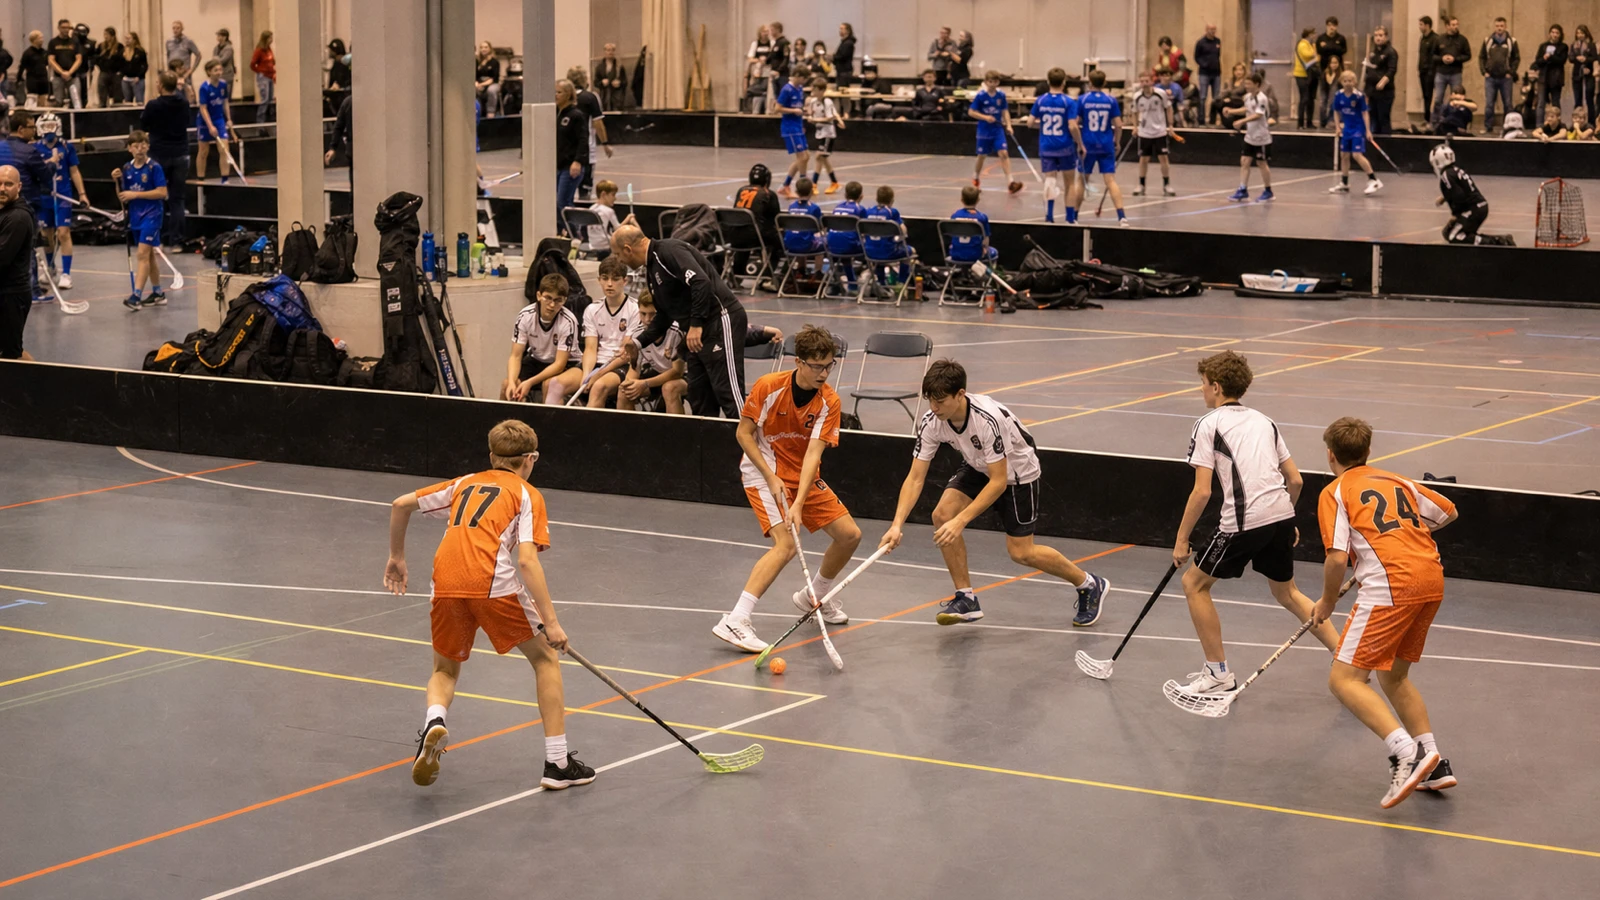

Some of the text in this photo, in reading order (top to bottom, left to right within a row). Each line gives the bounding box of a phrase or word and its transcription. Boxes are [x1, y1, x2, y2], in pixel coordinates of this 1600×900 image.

[1042, 113, 1064, 136] 22
[1088, 110, 1109, 132] 87
[453, 483, 502, 528] 17
[1359, 486, 1421, 534] 24
